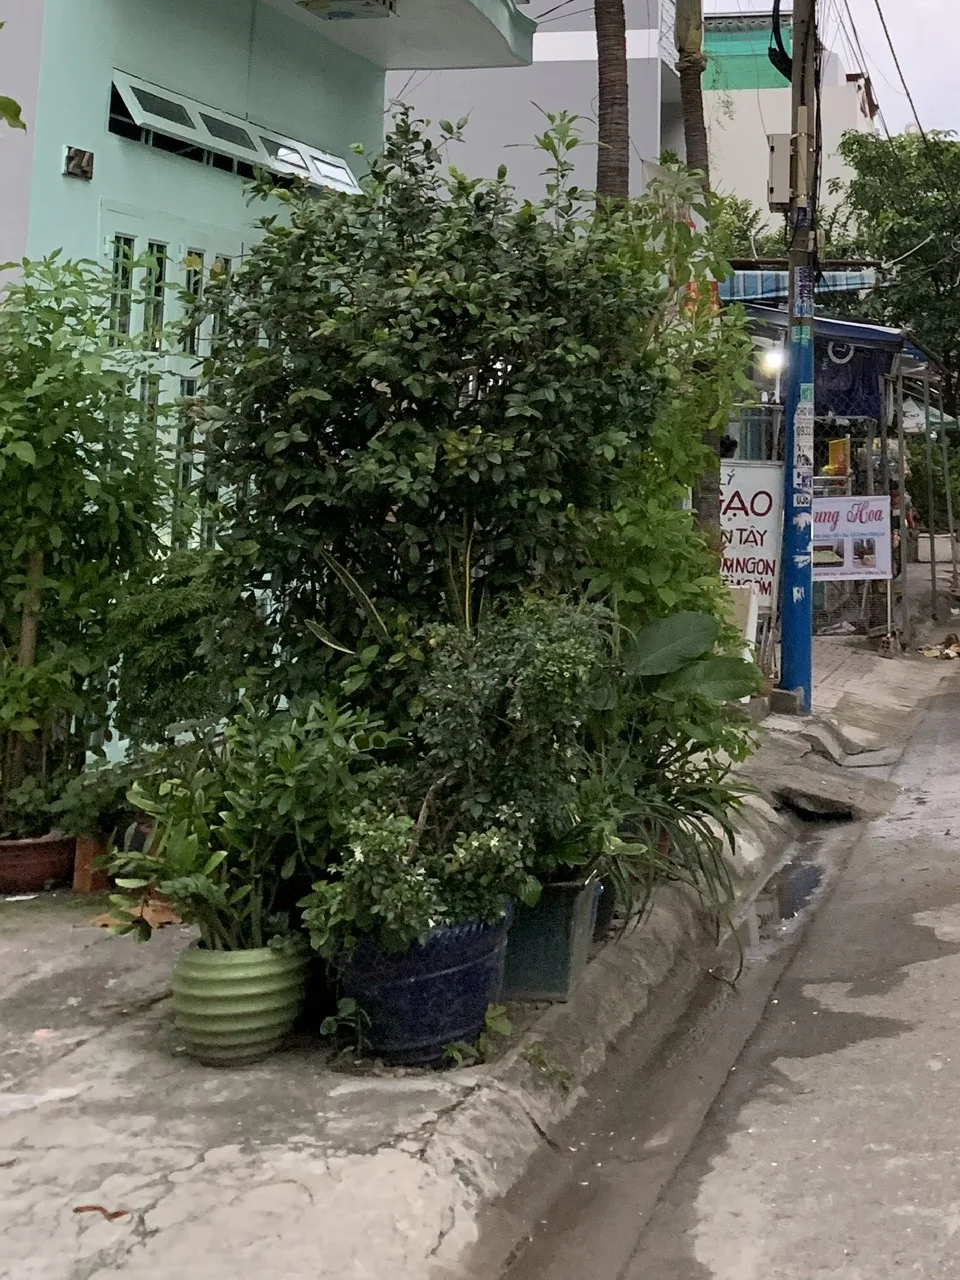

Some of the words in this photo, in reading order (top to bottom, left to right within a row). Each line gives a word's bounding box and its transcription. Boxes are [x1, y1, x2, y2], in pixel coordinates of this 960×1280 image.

[68, 148, 92, 178] 24
[813, 509, 839, 532] ung
[736, 525, 768, 547] TÂY
